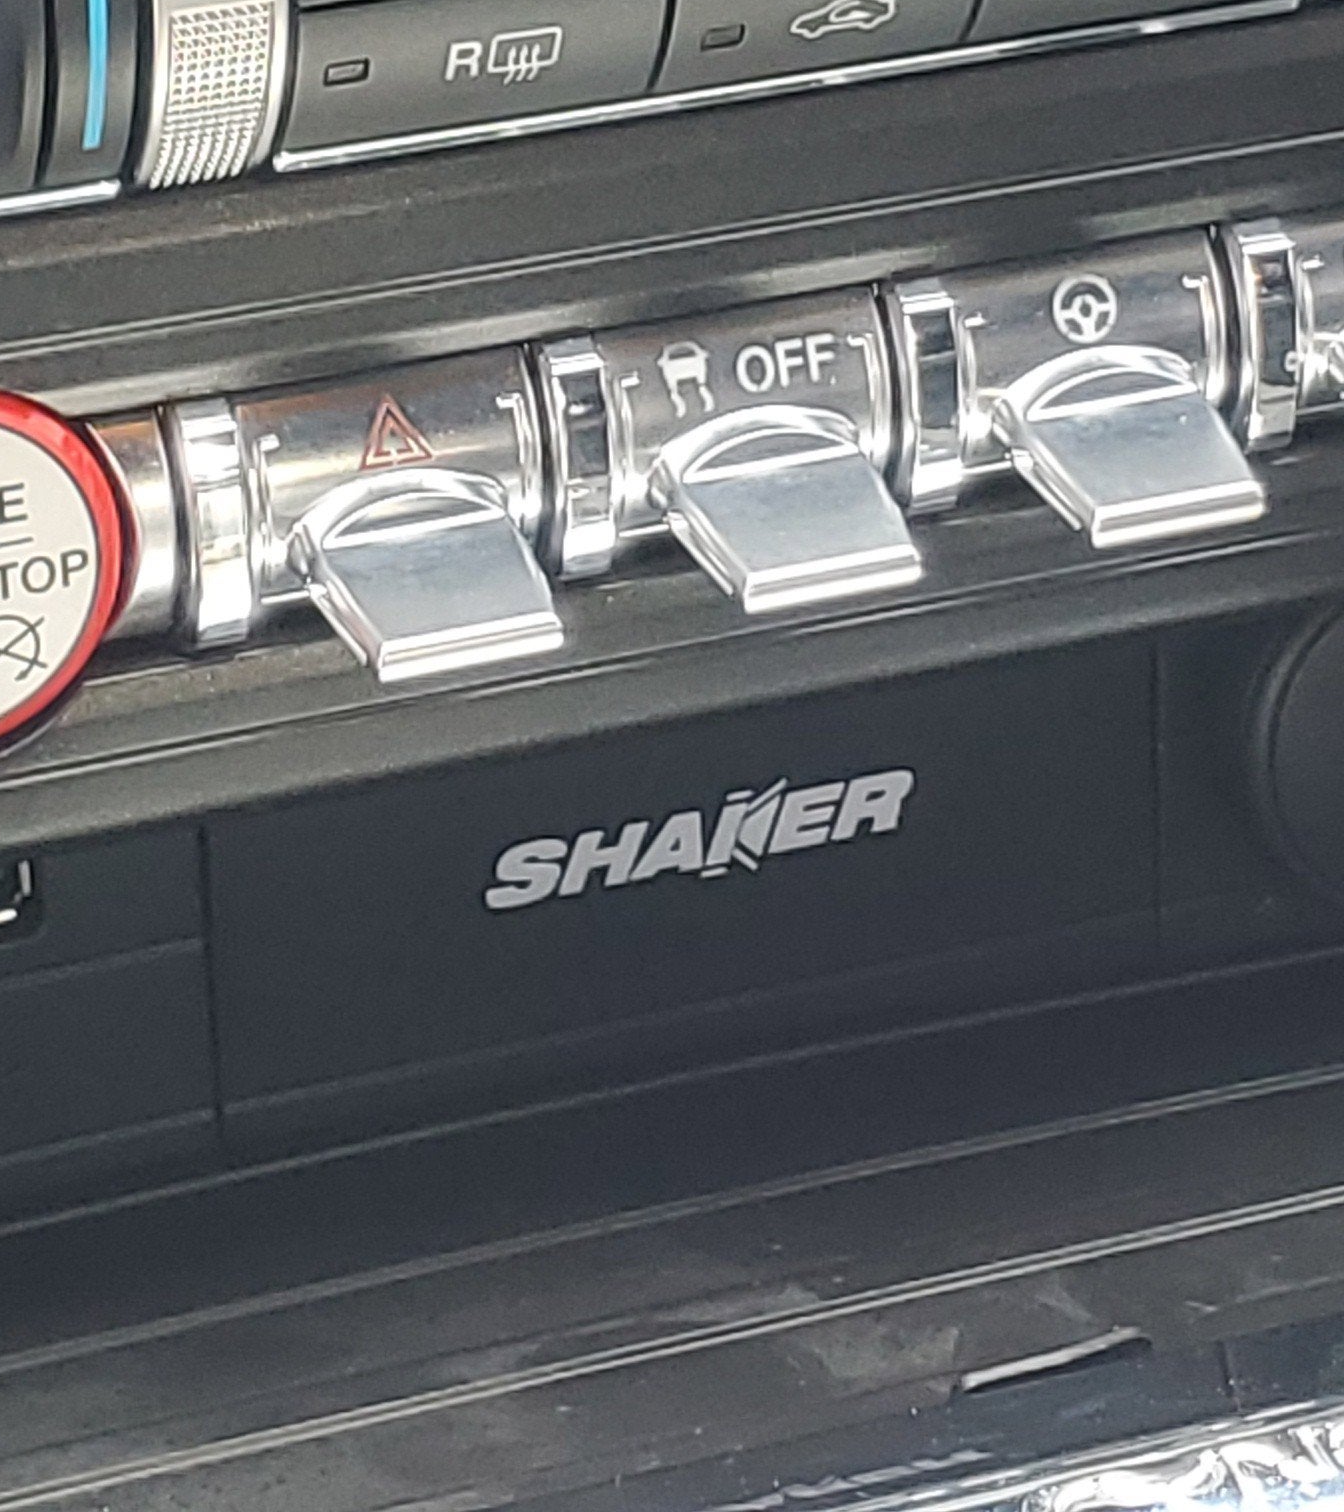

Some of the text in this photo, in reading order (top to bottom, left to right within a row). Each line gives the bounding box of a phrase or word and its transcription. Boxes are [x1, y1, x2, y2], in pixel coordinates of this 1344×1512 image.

[444, 42, 480, 82] R
[735, 332, 838, 392] OFF
[484, 768, 916, 912] SHAKER
